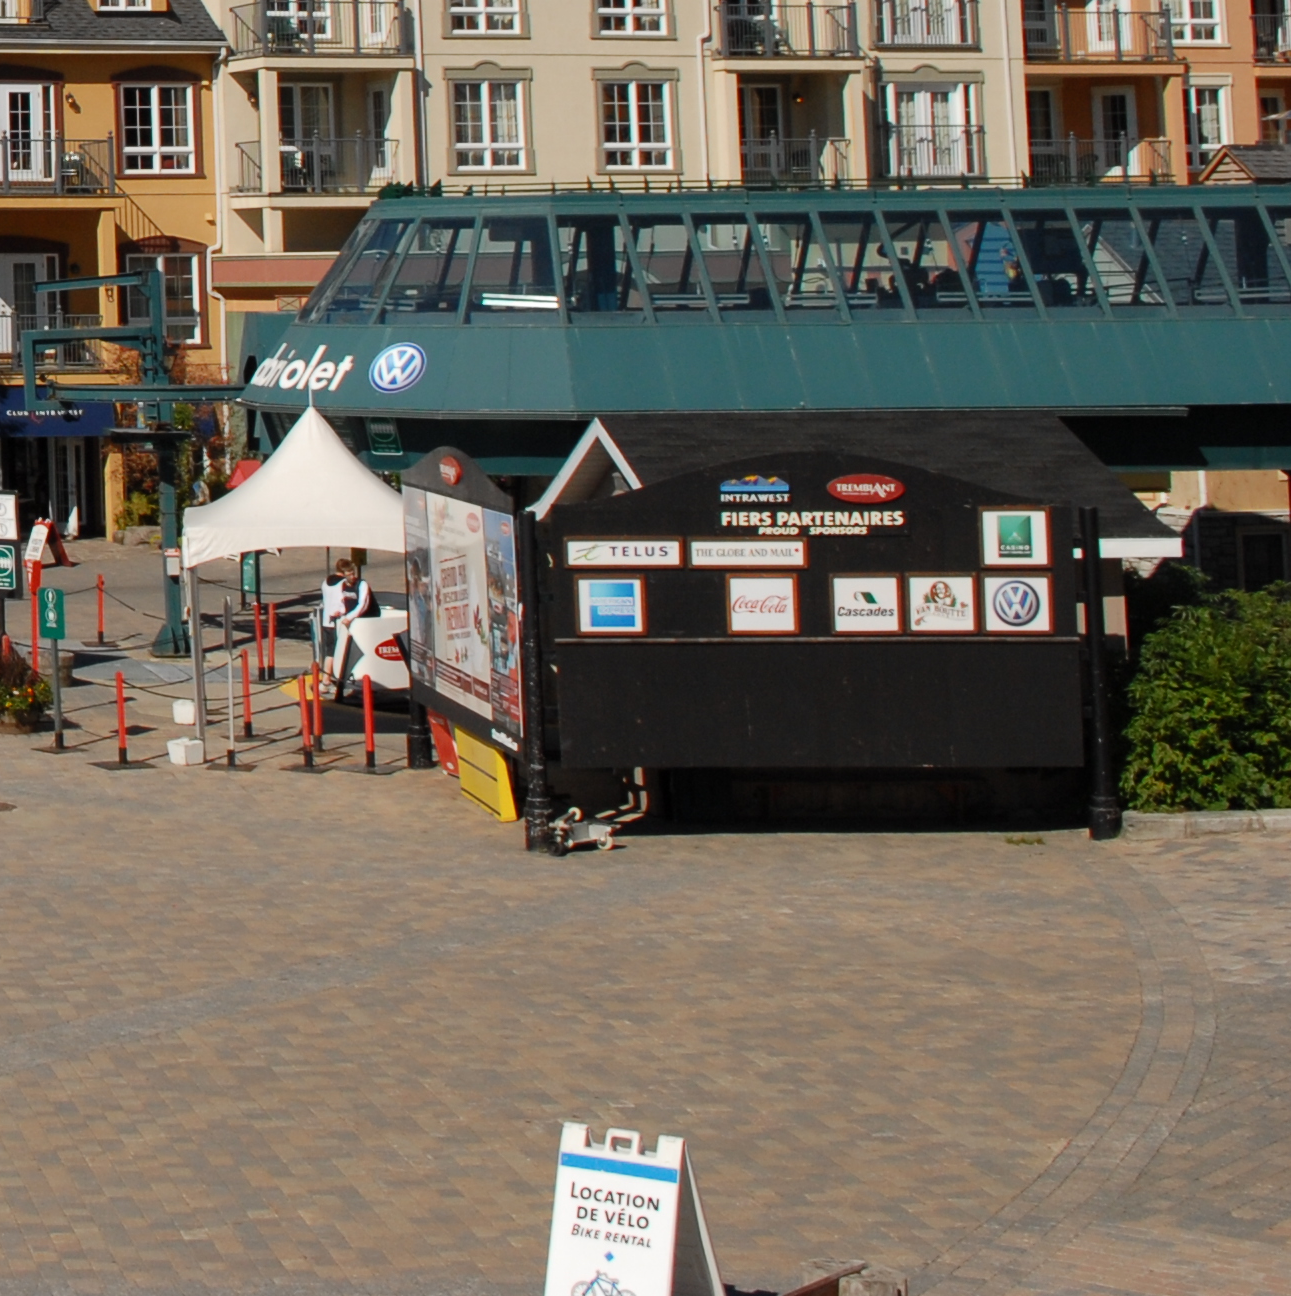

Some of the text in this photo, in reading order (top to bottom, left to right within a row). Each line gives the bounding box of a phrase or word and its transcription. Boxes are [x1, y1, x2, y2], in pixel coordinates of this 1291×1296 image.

[250, 342, 354, 391] abriolet
[835, 482, 896, 498] TREMBLANT
[720, 493, 791, 502] INTRAWEST
[721, 510, 905, 526] FIERS PARTENAIRES
[758, 526, 868, 535] PROUD SPONSORS
[609, 546, 669, 557] TELUS
[695, 548, 794, 557] THE GLOBE AND MAIL
[591, 597, 633, 605] AMERICAN
[598, 606, 635, 615] EXPRESS
[837, 606, 895, 617] Cascades
[570, 1181, 660, 1211] LOCATION
[576, 1205, 649, 1229] DE VÉLO
[571, 1223, 651, 1248] BIKE RENTAL
